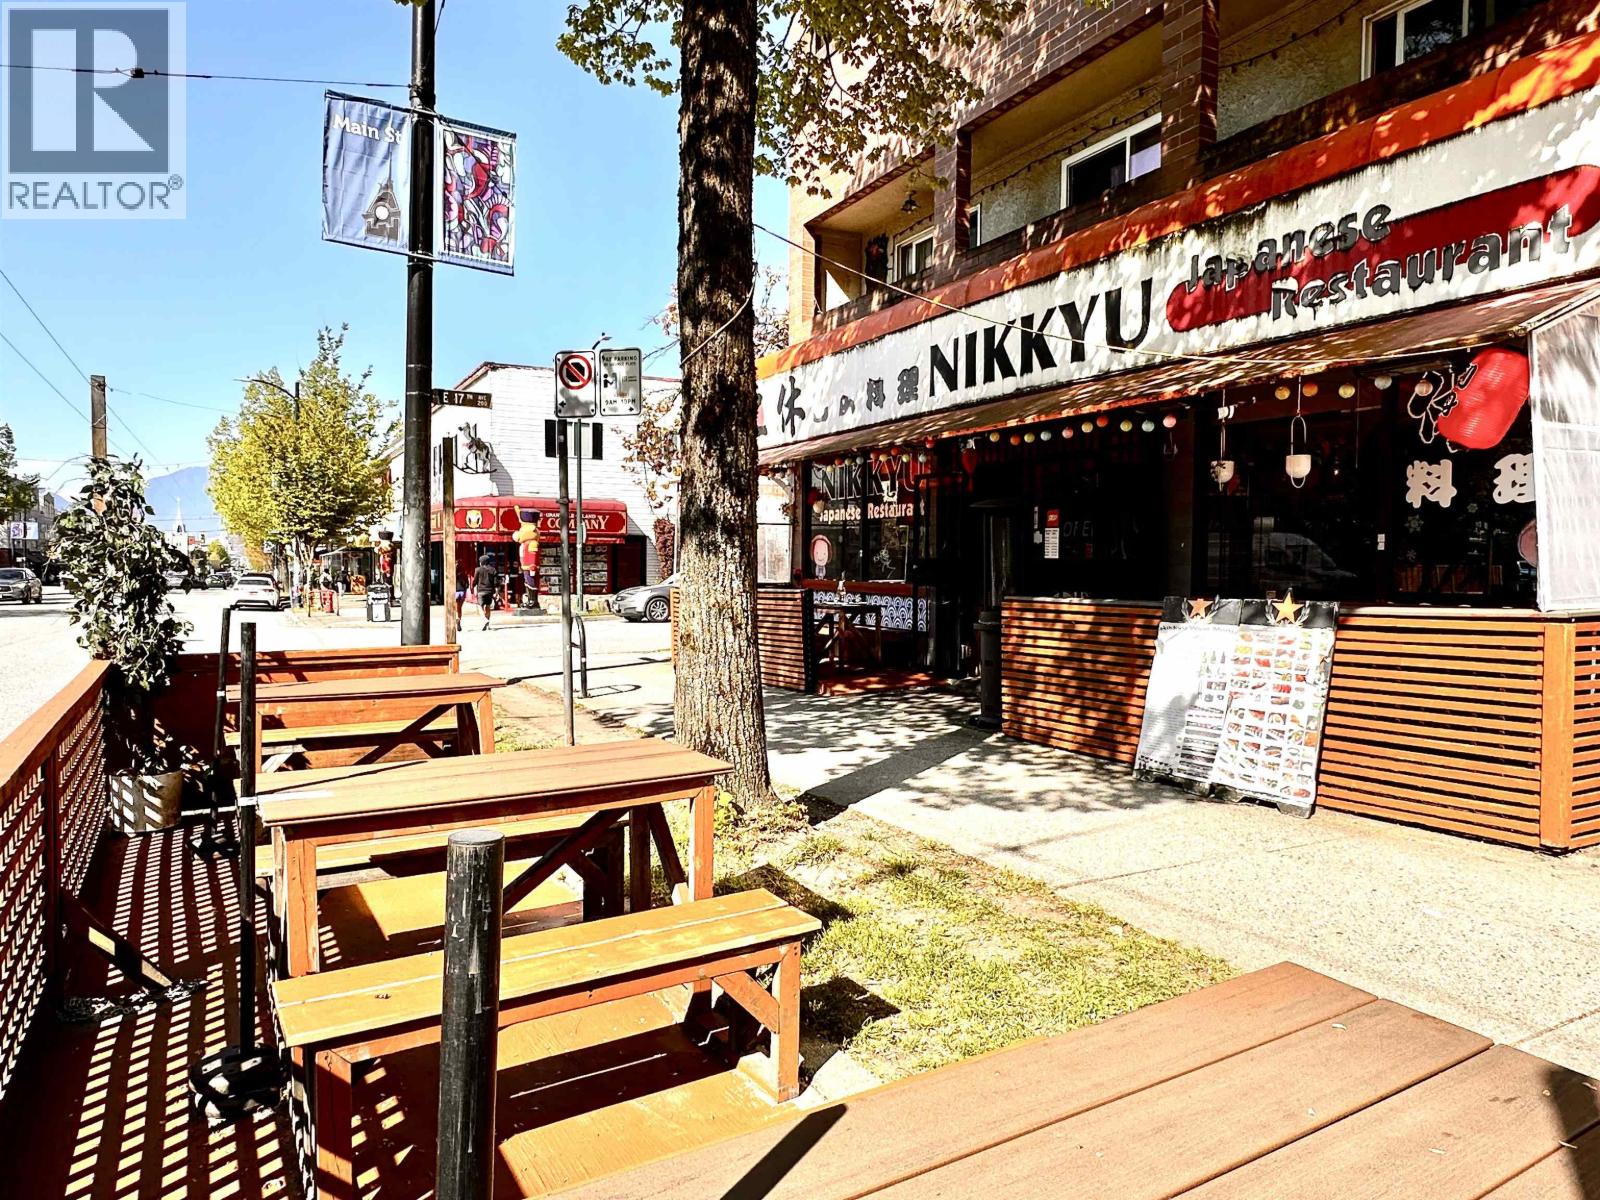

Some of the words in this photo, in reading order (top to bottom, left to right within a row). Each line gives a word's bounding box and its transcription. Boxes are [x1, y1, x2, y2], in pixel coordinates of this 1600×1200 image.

[333, 114, 379, 140] Main
[1187, 204, 1391, 292] Japanese
[1271, 204, 1573, 321] Restaurant
[929, 277, 1153, 397] NIKKYU
[443, 392, 449, 403] E
[812, 453, 926, 500] NIKKYU
[867, 500, 925, 519] Restaurat
